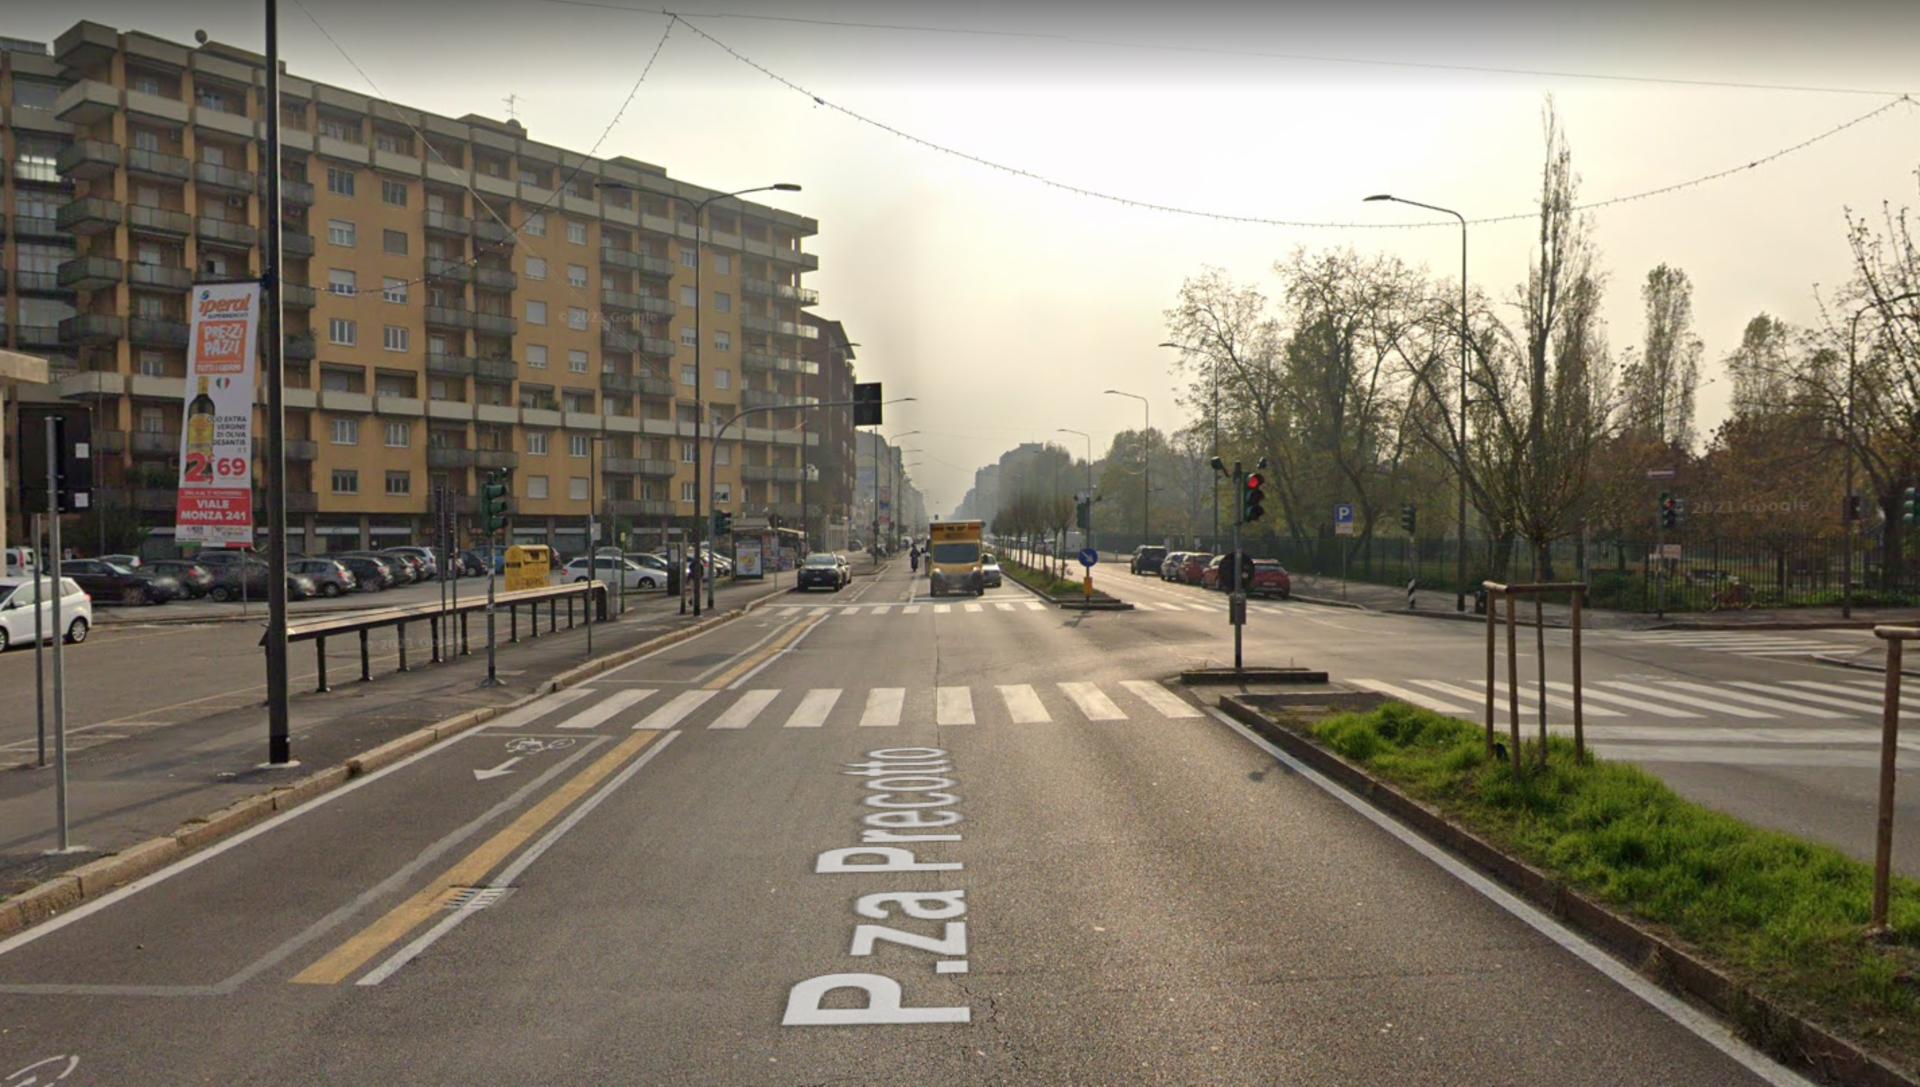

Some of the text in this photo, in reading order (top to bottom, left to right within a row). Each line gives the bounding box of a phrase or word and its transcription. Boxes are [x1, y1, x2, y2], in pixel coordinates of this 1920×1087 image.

[205, 324, 243, 341] PREZZI
[204, 338, 241, 357] PAZZI
[196, 500, 229, 509] VIALE
[180, 510, 247, 520] MONZA 241
[1339, 507, 1350, 520] P
[782, 747, 971, 1026] P.za Precotto
